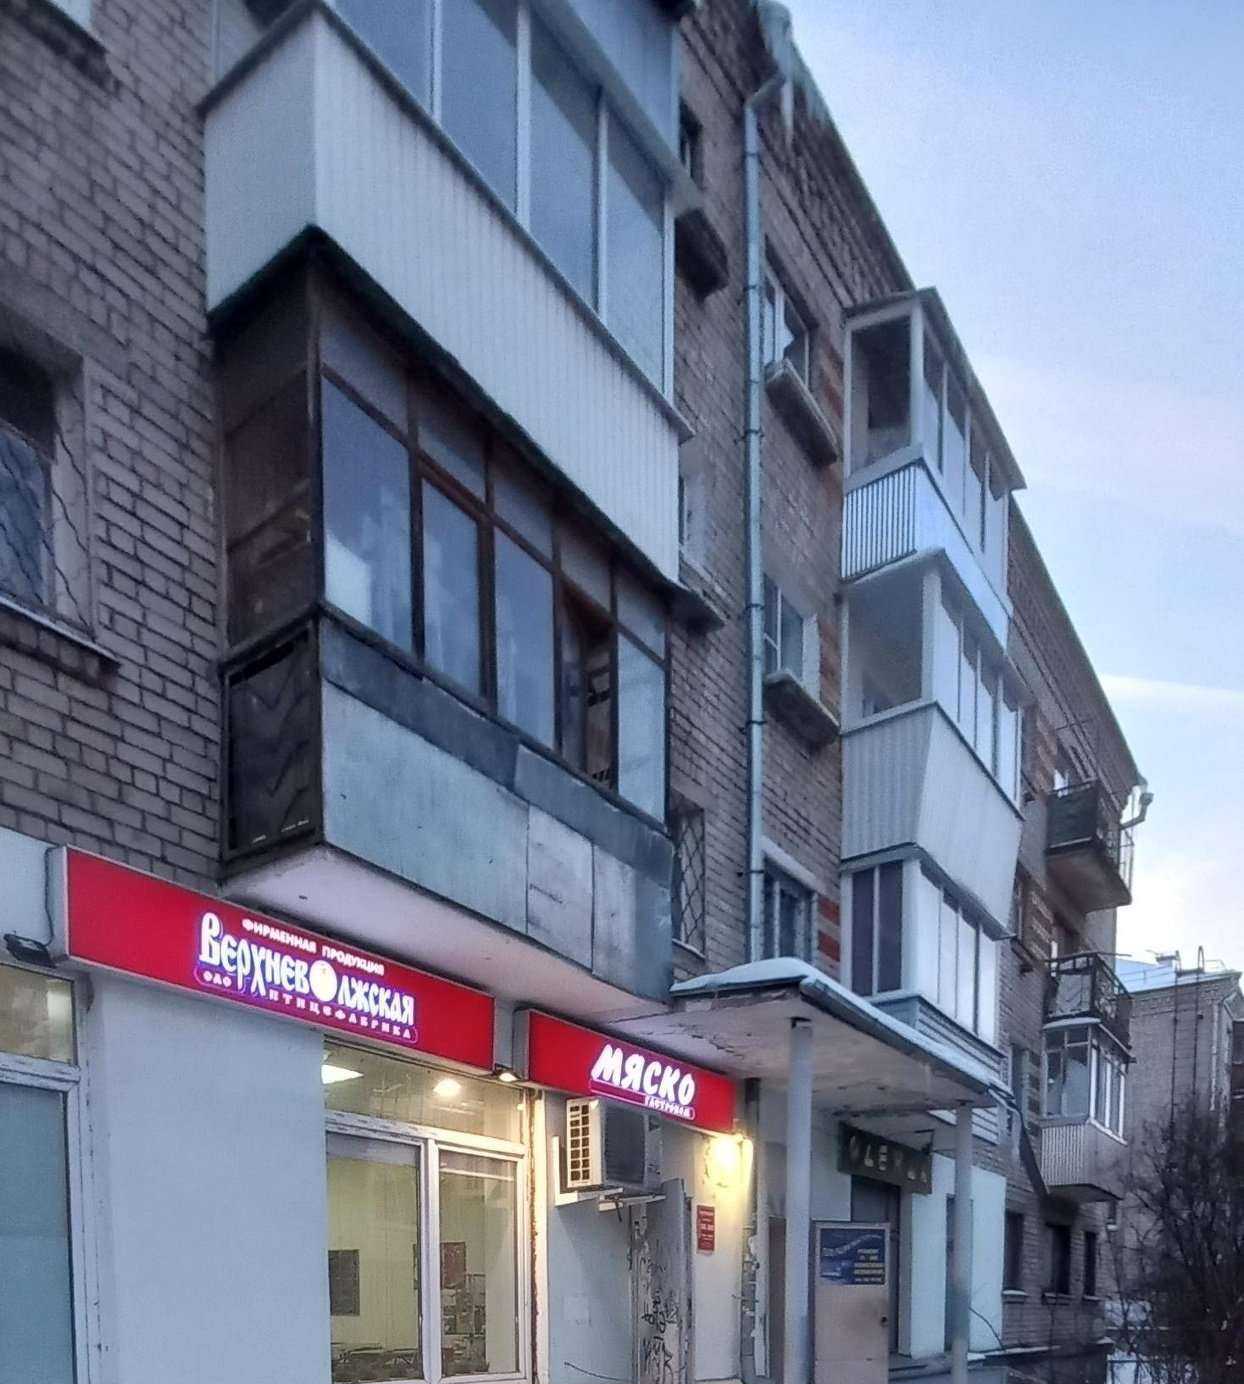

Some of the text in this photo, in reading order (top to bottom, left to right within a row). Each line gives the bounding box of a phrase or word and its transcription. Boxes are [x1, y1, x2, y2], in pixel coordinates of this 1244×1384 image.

[242, 918, 385, 976] ФИРМЕННАЯ ПРОДУКЦИЯ
[202, 970, 412, 1039] ОАО ПТИЦЕФАБРИКА
[591, 1044, 695, 1106] МЯСКО
